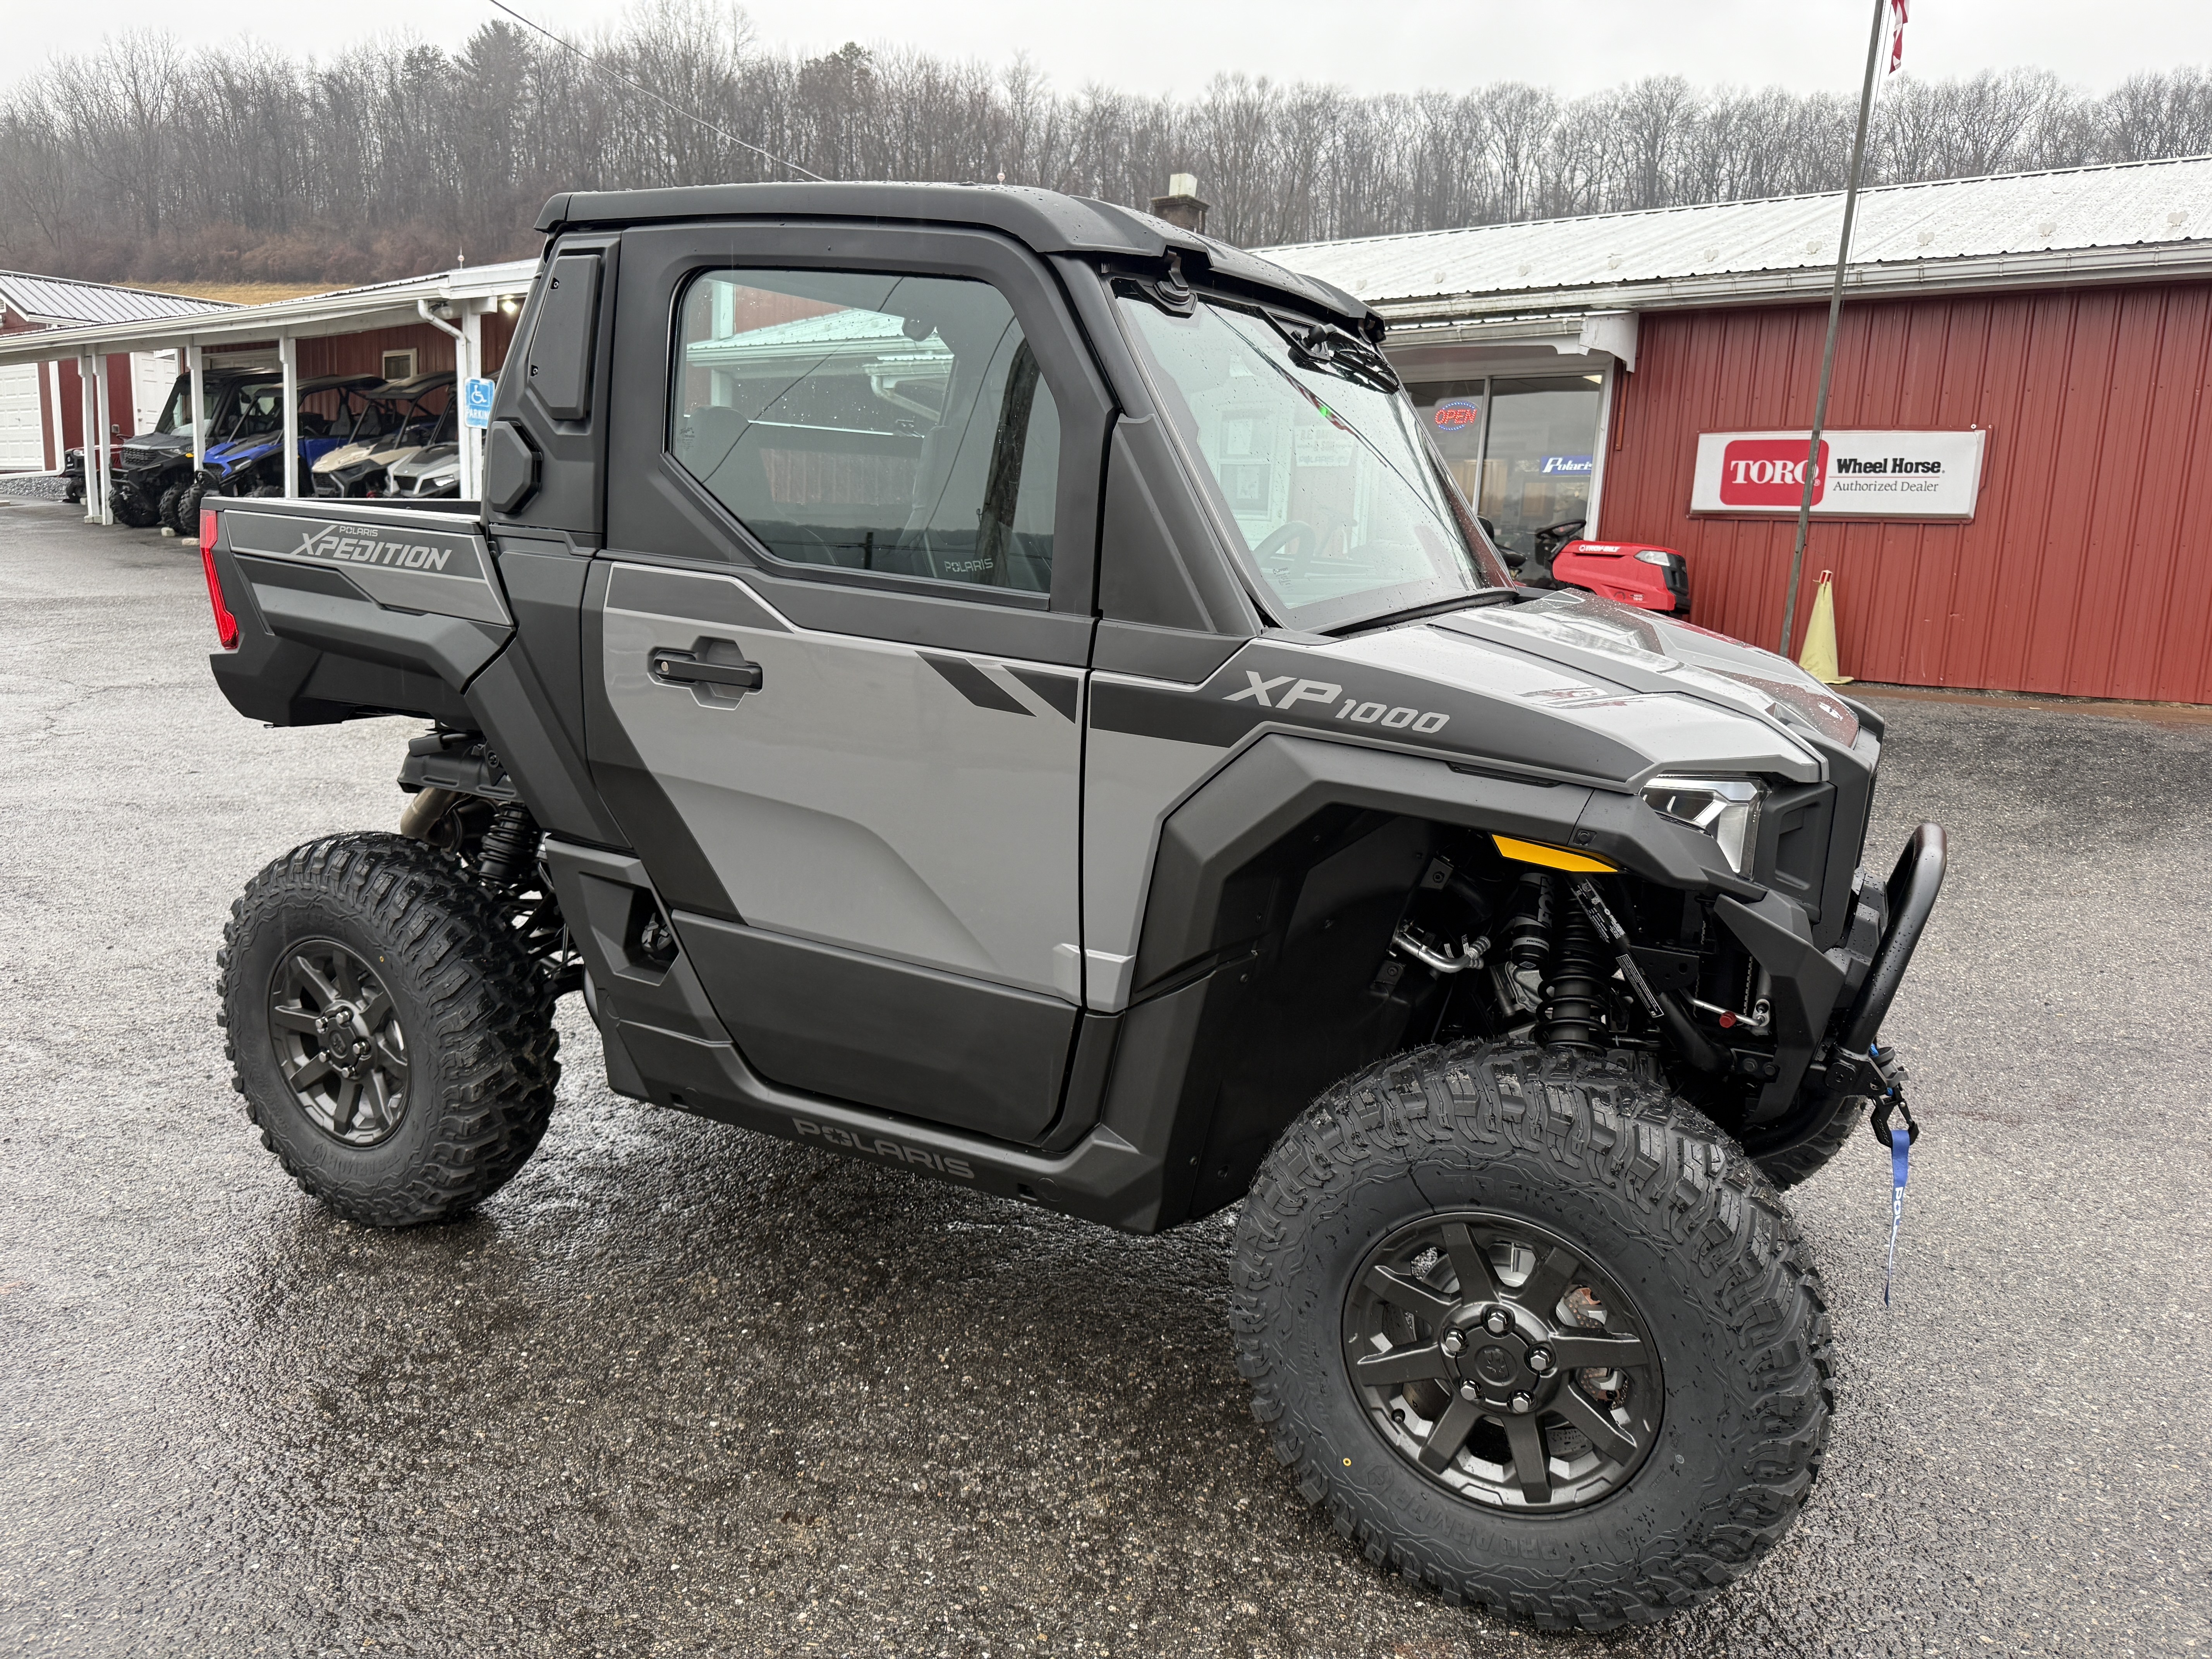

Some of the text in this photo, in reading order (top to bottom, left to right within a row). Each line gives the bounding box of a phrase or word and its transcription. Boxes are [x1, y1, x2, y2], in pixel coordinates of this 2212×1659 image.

[465, 405, 490, 420] PARKIN
[1435, 409, 1477, 424] OPEN
[1730, 460, 1819, 484] TORO
[1837, 458, 1888, 474] Wheel
[1833, 481, 1939, 491] Authorized Dealer
[339, 526, 378, 537] POLARIS
[290, 525, 452, 571] XPEDITION
[944, 558, 994, 572] POLARIS
[1222, 670, 1450, 733] XP 1000
[1537, 876, 1554, 928] FOX
[792, 1118, 975, 1179] POLARIS
[1389, 1489, 1561, 1561] PRO ARMOR
